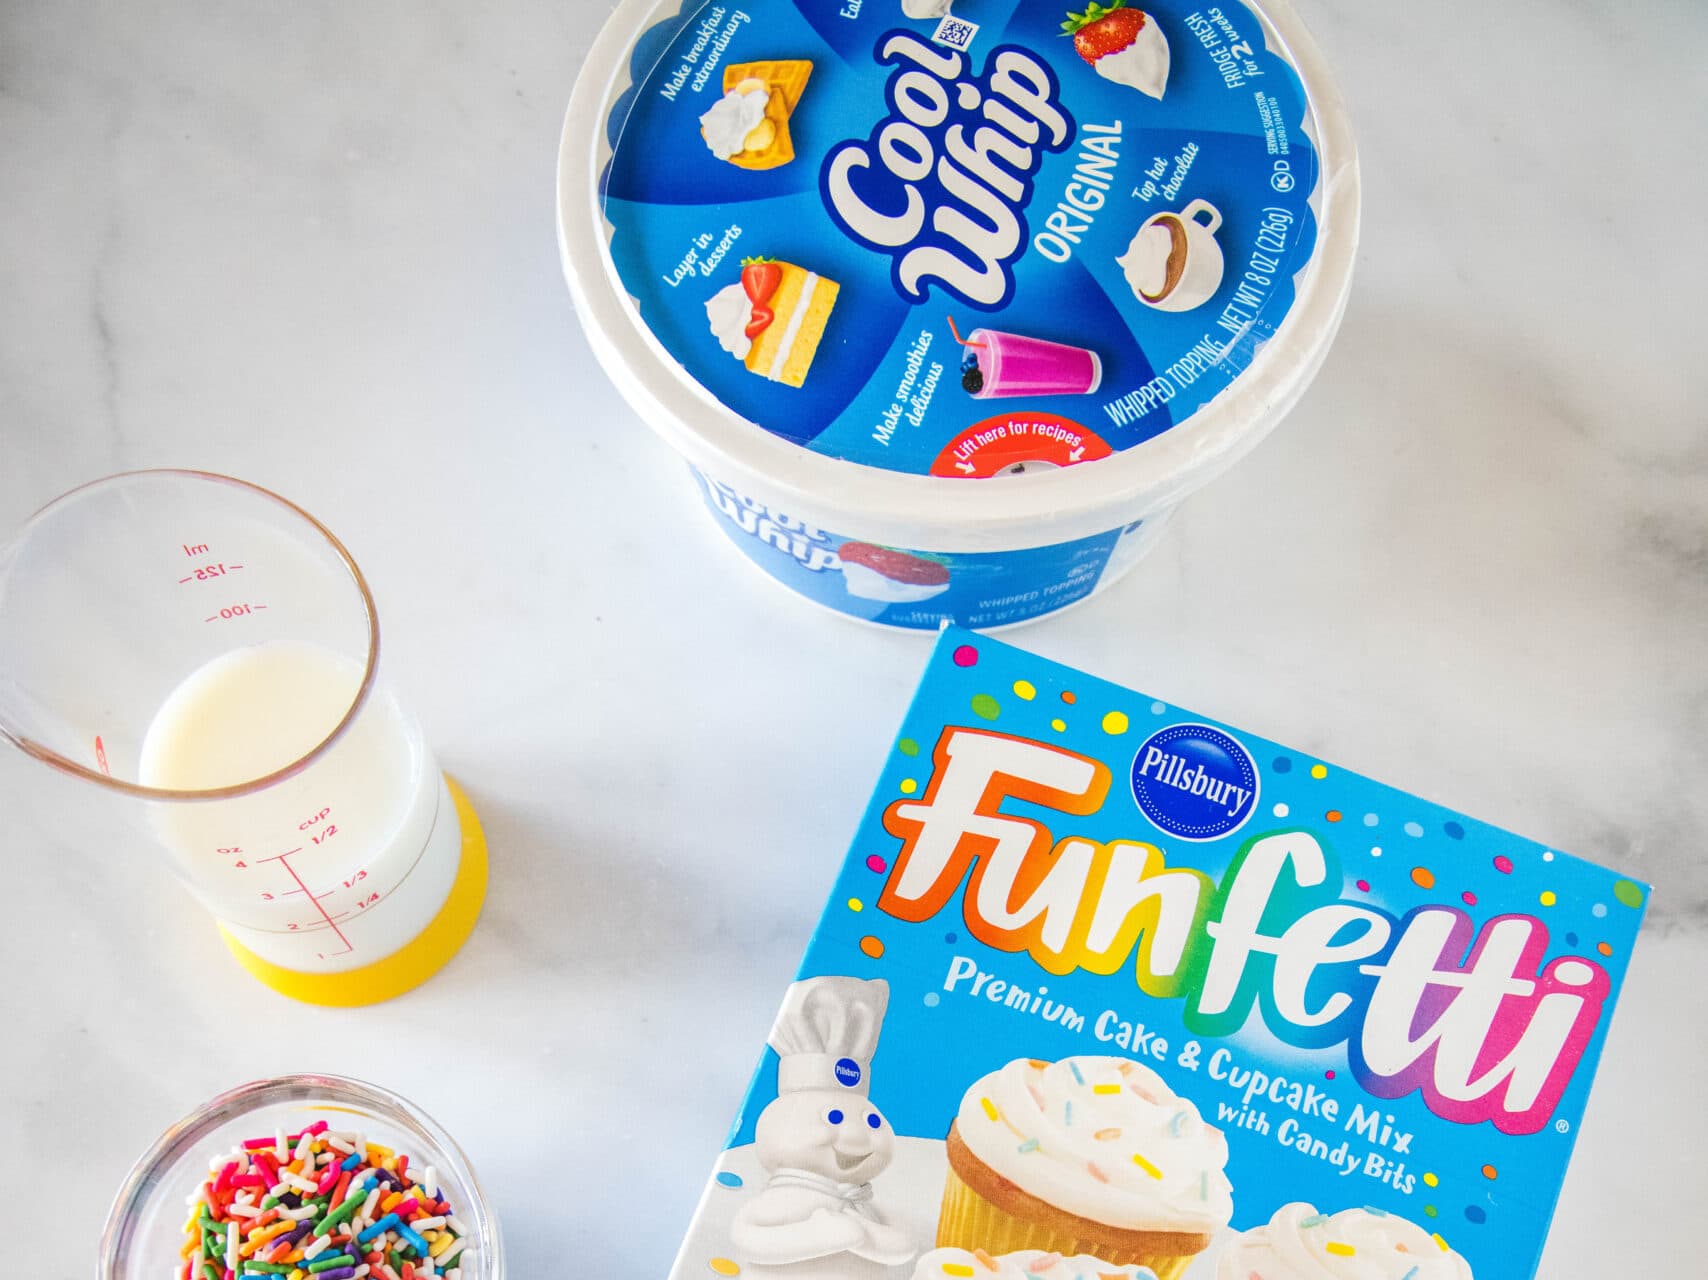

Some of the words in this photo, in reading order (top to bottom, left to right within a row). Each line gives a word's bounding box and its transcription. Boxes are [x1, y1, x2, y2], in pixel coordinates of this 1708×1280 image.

[1184, 12, 1222, 49] FRESH
[1208, 7, 1240, 42] weeks
[660, 64, 692, 101] Make
[681, 6, 726, 64] breakfast
[691, 10, 751, 93] extraordinary
[1209, 45, 1246, 89] FRIDGE
[1231, 40, 1254, 60] 2
[1242, 59, 1265, 77] for
[1254, 91, 1274, 128] SUGGESTION
[826, 33, 964, 248] Cool
[1264, 128, 1279, 154] SERVING
[898, 50, 1068, 305] Whip
[1144, 156, 1168, 181] hot
[1160, 142, 1199, 202] chocolate
[1033, 119, 1122, 264] ORIGINAL
[1131, 181, 1160, 202] Top
[698, 224, 742, 277] desserts
[1255, 207, 1294, 254] (226g)
[662, 248, 698, 288] Layer
[692, 233, 714, 249] in
[1244, 272, 1271, 287] 8
[1249, 252, 1280, 275] OZ
[1233, 281, 1265, 319] WT
[1165, 334, 1226, 389] TOPPING
[871, 401, 904, 447] Make
[896, 329, 933, 403] smoothies
[904, 362, 943, 428] delicious
[1103, 376, 1176, 429] WHIPPED
[953, 434, 979, 461] Lift
[977, 426, 1007, 449] here
[1008, 420, 1029, 436] for
[1031, 421, 1082, 447] recipes
[978, 589, 1039, 609] WHIPPED
[1043, 570, 1098, 596] TOPPING
[1138, 744, 1253, 818] Pillsbury
[299, 807, 331, 831] cup
[311, 824, 338, 845] 1/2
[235, 860, 247, 868] 4
[343, 870, 368, 889] 1/3
[261, 893, 275, 901] 3
[356, 892, 381, 909] 1/4
[890, 729, 1602, 1118] Funfetti
[943, 955, 1086, 1033] Premium
[1094, 1010, 1169, 1061] Cake
[1177, 1040, 1202, 1072] &
[1207, 1048, 1340, 1122] Cupcake
[1344, 1103, 1415, 1155] Mix
[1218, 1102, 1271, 1137] with
[1277, 1118, 1362, 1177] Candy
[1363, 1152, 1417, 1195] Bits
